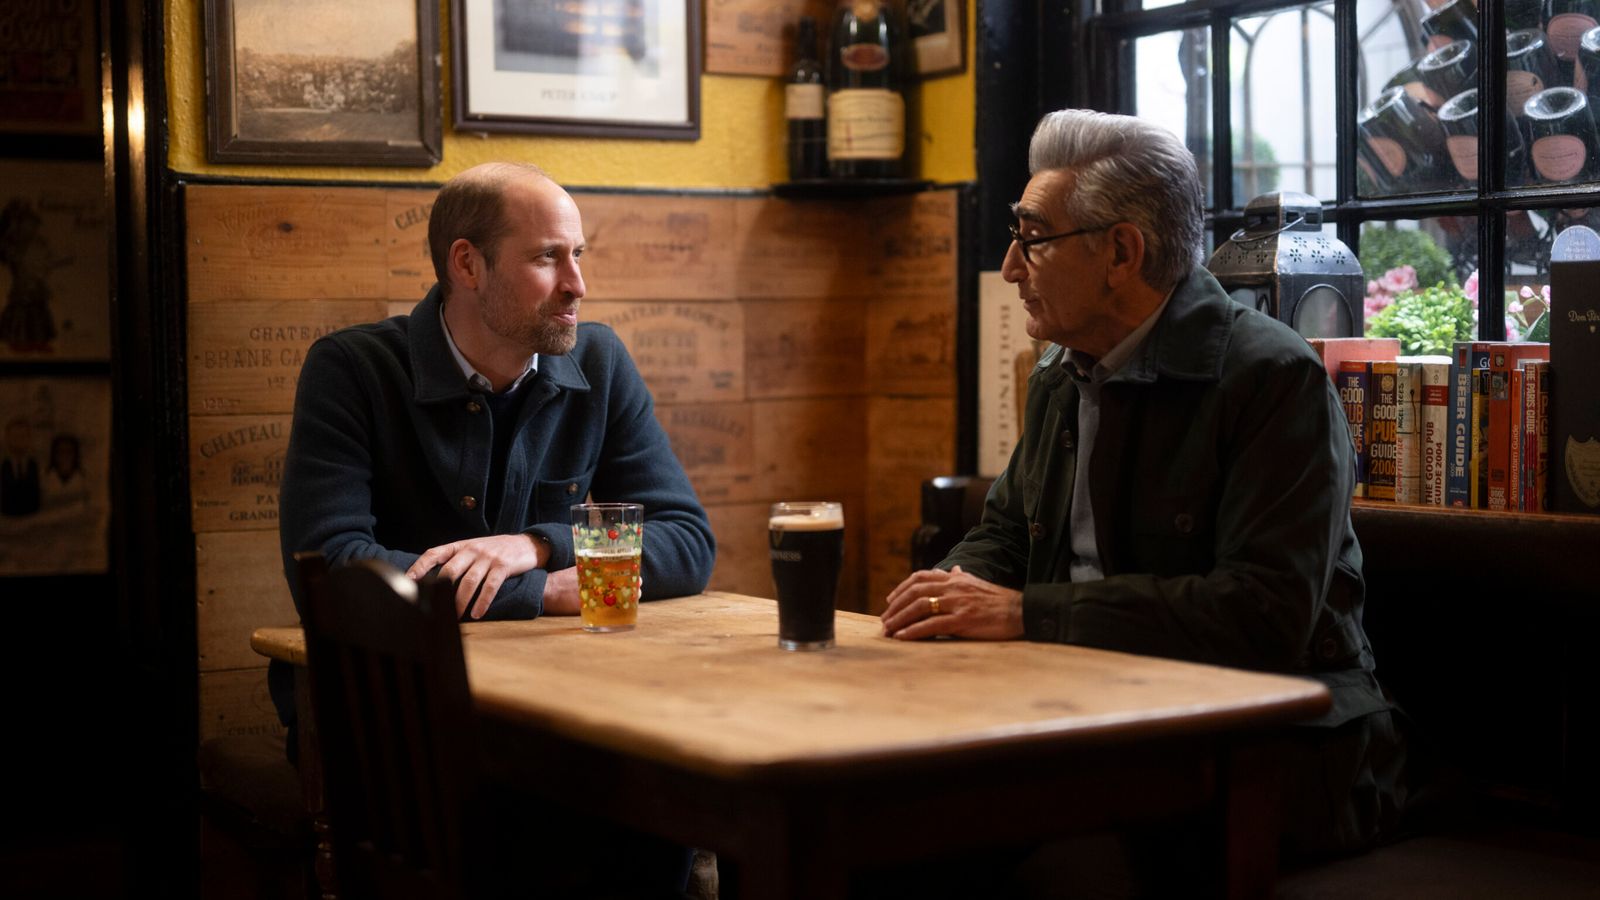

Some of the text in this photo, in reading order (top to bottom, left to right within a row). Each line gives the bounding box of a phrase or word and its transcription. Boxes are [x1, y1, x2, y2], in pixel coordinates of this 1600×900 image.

[1347, 376, 1360, 387] THE
[1340, 387, 1364, 403] GOOD
[1381, 393, 1393, 403] THE
[1456, 373, 1466, 419] BEER
[1526, 364, 1534, 434] THE PARIS GUIDE
[1373, 405, 1397, 420] GOOD
[200, 422, 282, 458] CHATEAU
[1372, 421, 1397, 442] PUB
[1371, 444, 1397, 458] GUIDE
[1455, 423, 1465, 477] GUIDE
[1425, 421, 1434, 505] THE GOOD PUB
[229, 510, 278, 521] GRAND
